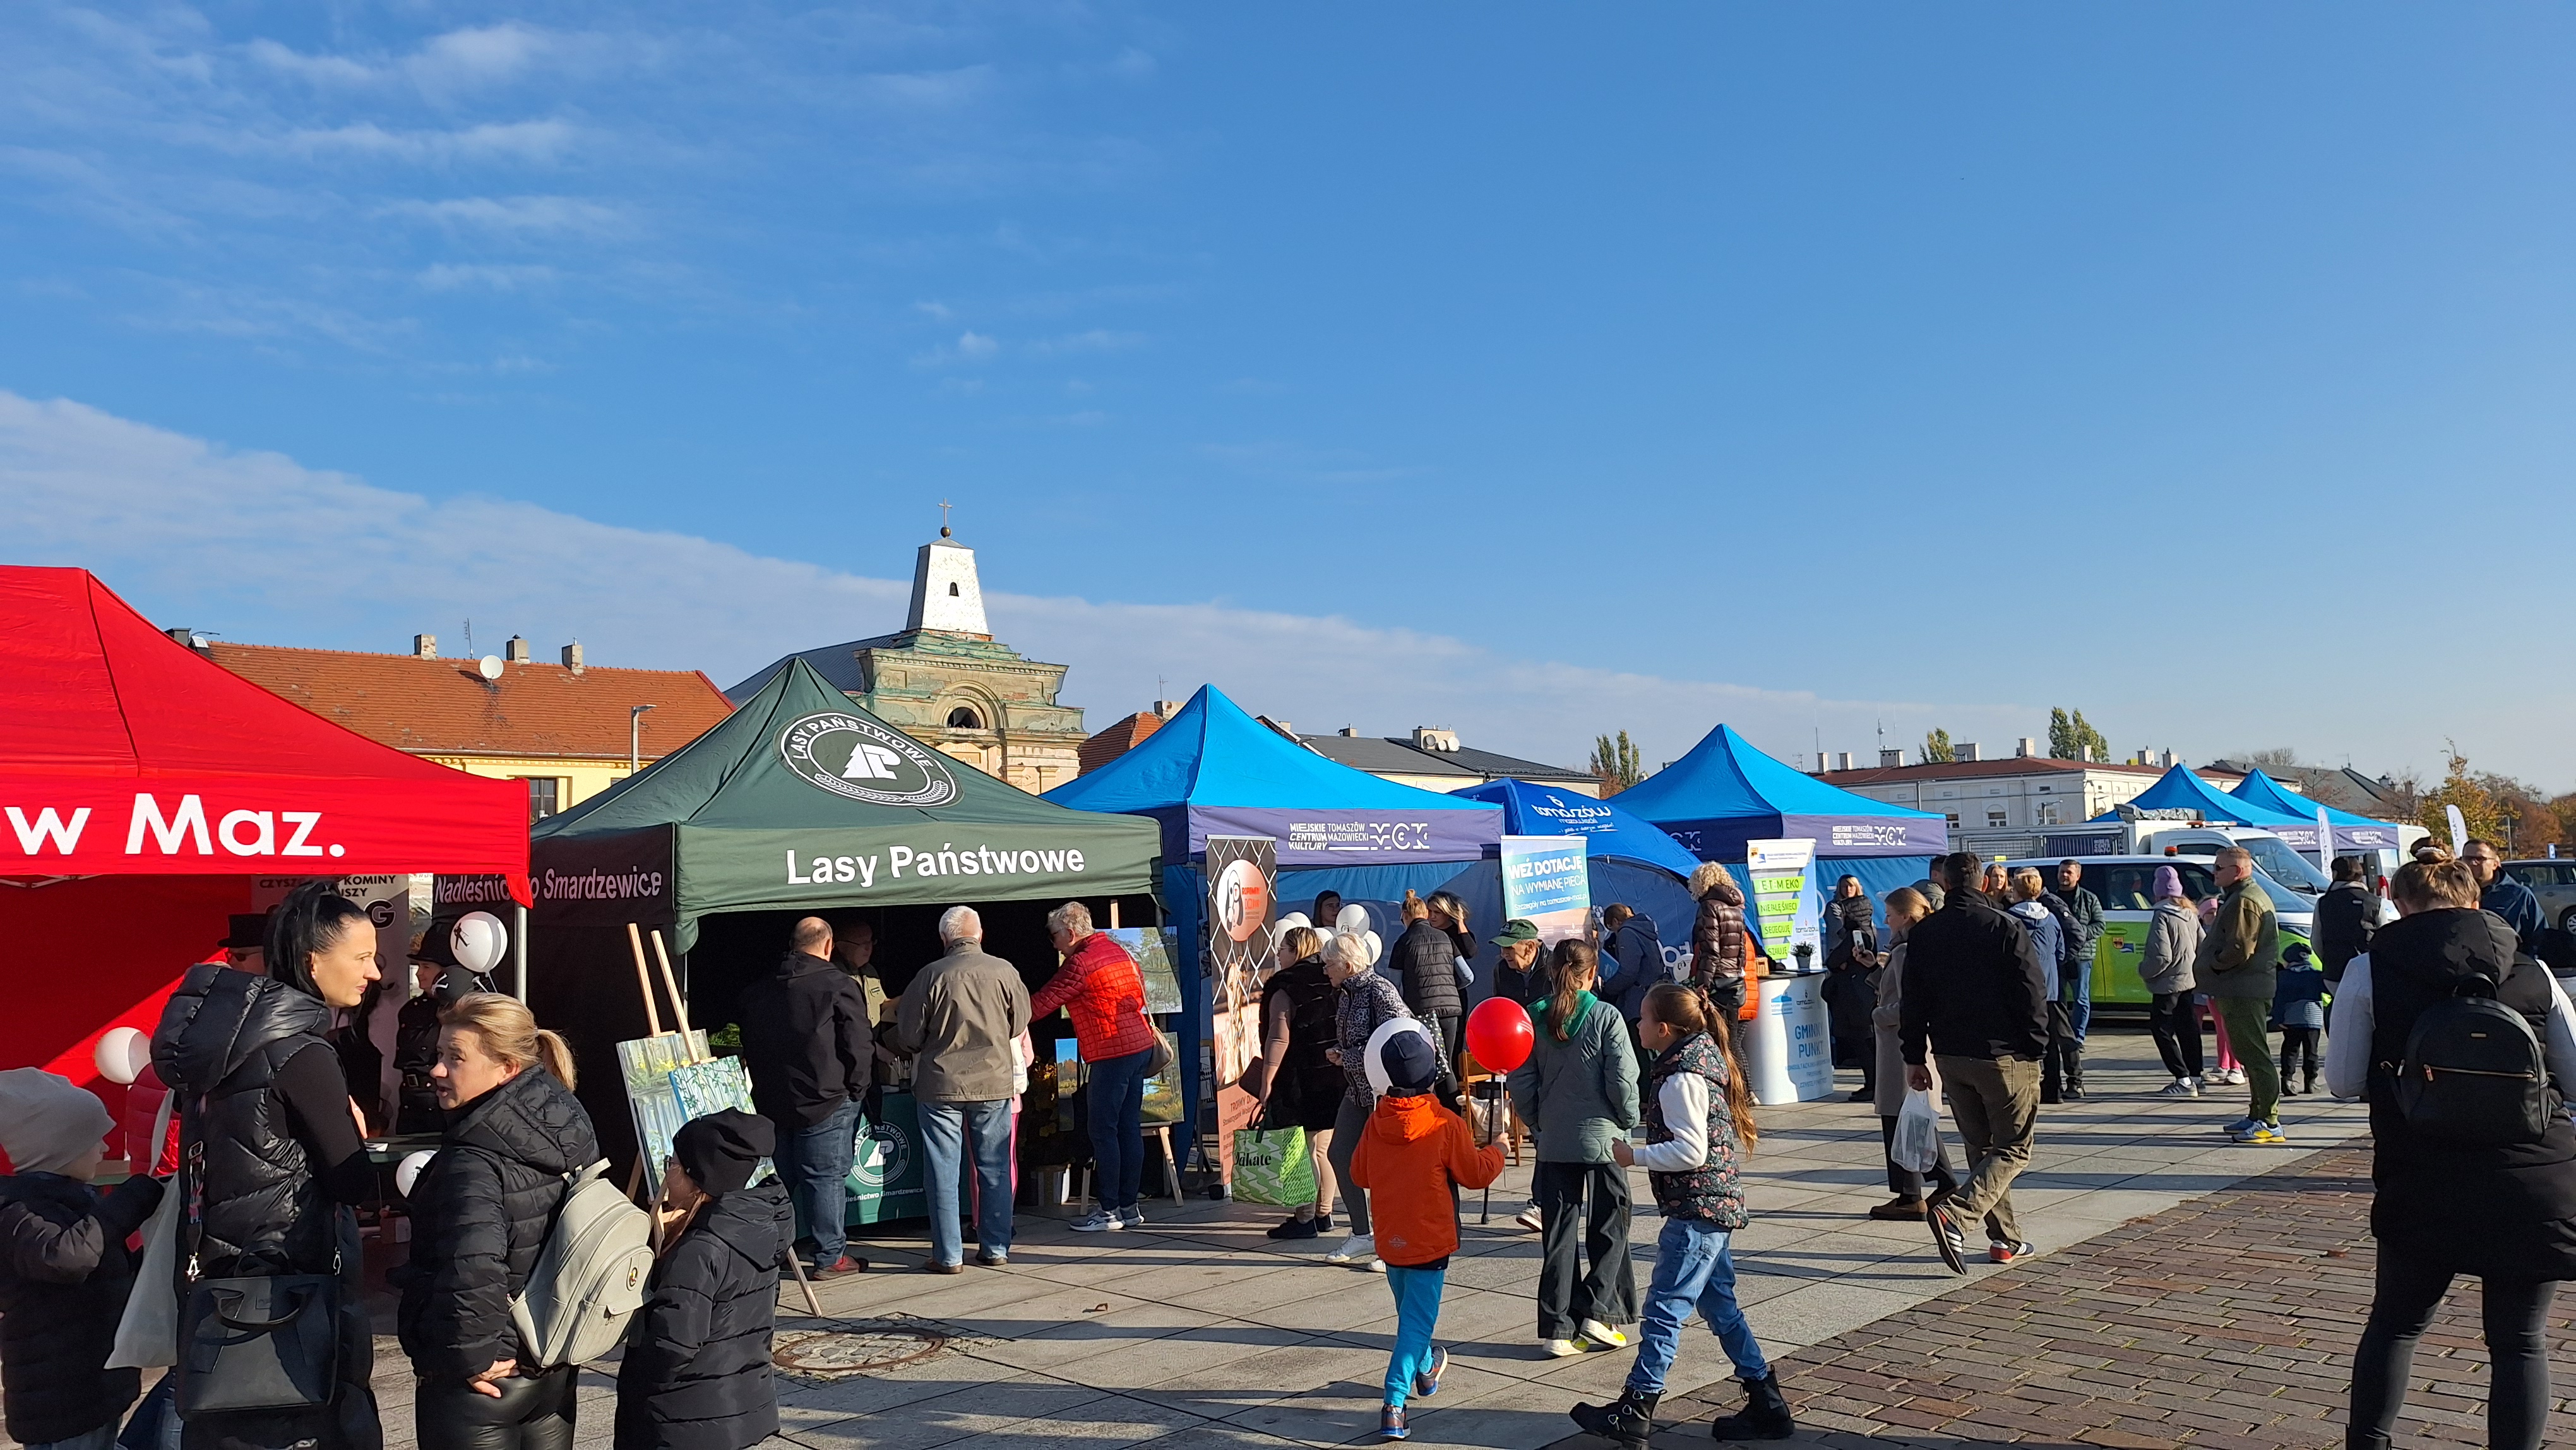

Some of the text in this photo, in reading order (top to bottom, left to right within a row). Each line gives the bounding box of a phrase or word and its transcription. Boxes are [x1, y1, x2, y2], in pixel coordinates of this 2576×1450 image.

[790, 716, 934, 768] LASY PAŃSTWOWE
[125, 793, 345, 857] Maz.
[1289, 823, 1326, 832] MIEJSKIE
[1327, 822, 1366, 832] TOMASZÓW
[1289, 832, 1327, 841] CENTRUM
[1327, 832, 1369, 841] MAZOWIECKI
[1288, 841, 1328, 851] KULTURY
[785, 842, 1085, 887] Lasy Państwowe
[1507, 855, 1584, 880] WEŹ DOTACJĘ
[344, 875, 397, 885] KOMINY
[544, 866, 662, 899] Smardzewice
[1510, 874, 1587, 897] NA WYMIANĘ PIECA
[1786, 878, 1799, 889] EKO
[1760, 904, 1770, 913] NIE
[1794, 1022, 1823, 1040] GMINNY
[1798, 1042, 1823, 1058] PUNKT
